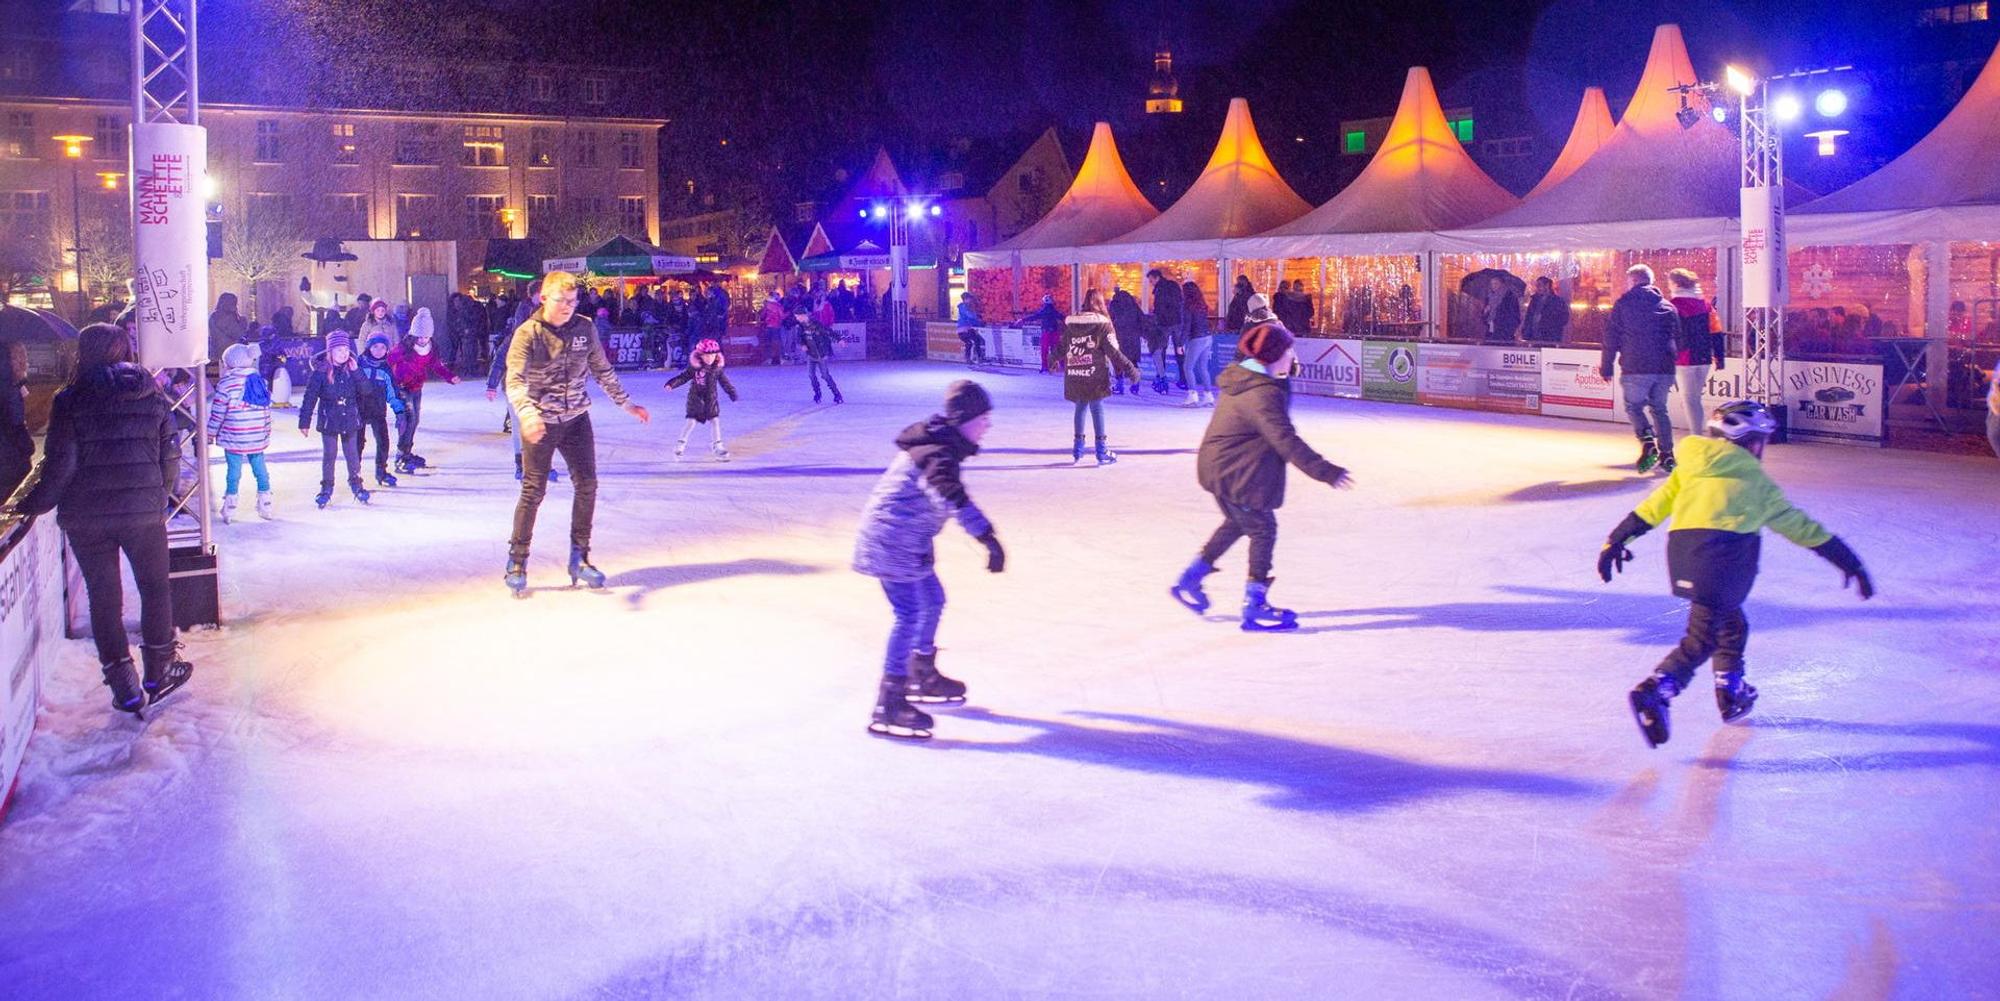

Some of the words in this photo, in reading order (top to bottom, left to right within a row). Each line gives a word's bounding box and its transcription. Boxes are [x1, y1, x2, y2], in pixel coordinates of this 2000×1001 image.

[153, 154, 168, 224] SCHETTE
[1503, 353, 1536, 365] BOHLE
[1299, 363, 1354, 383] RTHAUS
[1789, 366, 1876, 396] BUSINESS
[1807, 404, 1827, 420] CAR
[1828, 405, 1857, 422] WASH
